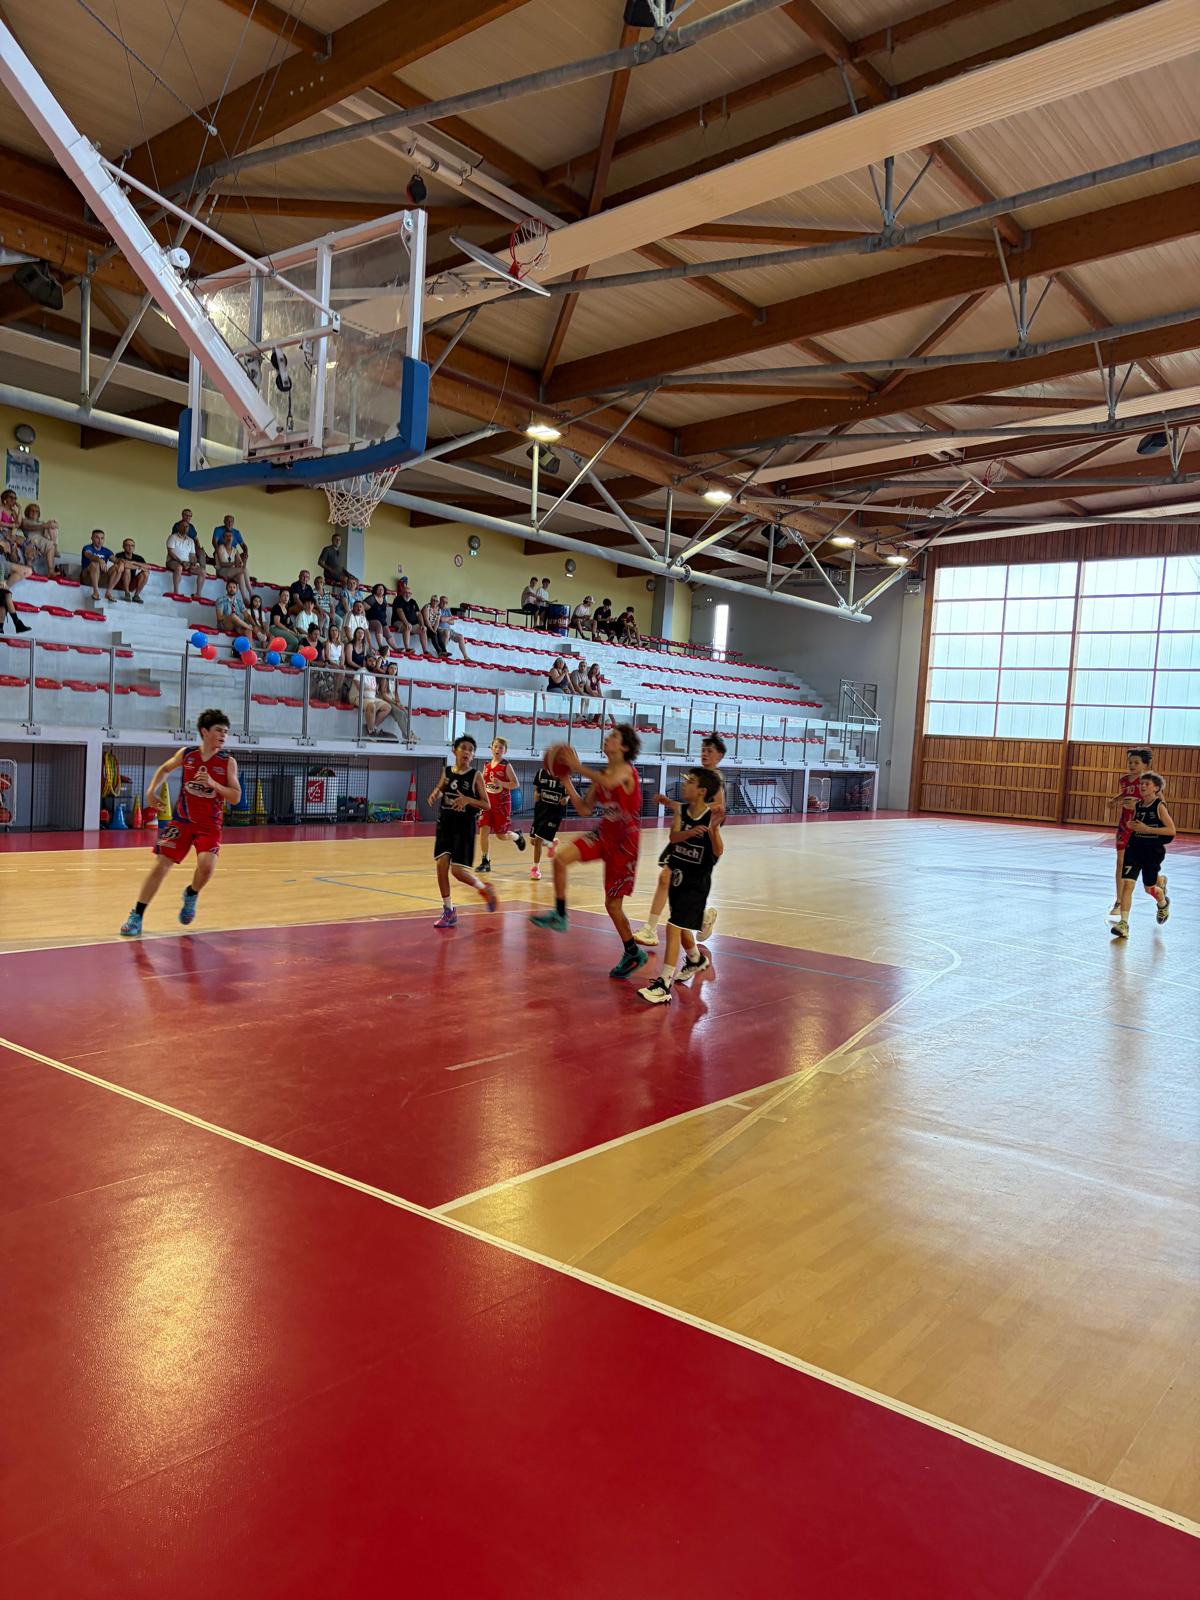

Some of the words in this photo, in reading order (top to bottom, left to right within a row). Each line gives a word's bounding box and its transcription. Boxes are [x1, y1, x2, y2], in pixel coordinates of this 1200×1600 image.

[450, 779, 459, 790] 6
[548, 779, 556, 789] 11
[1124, 866, 1133, 875] 7
